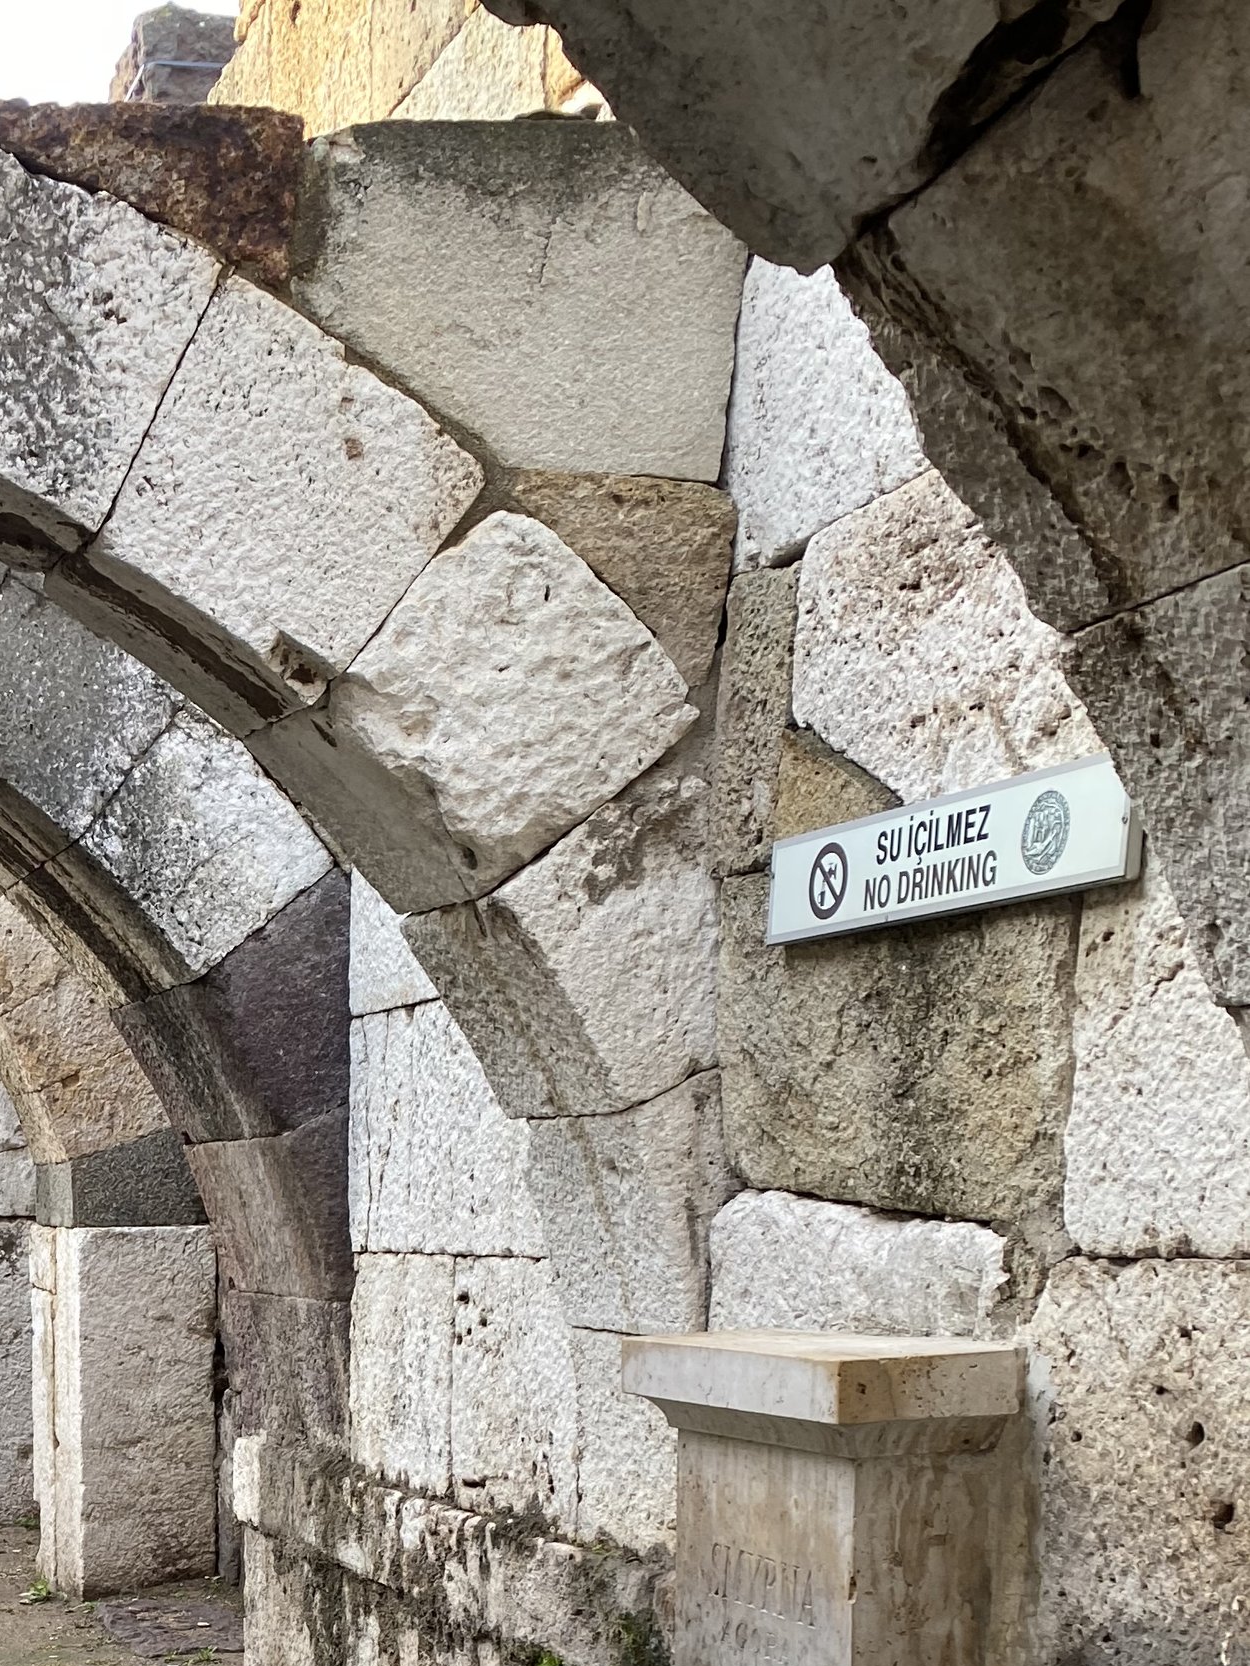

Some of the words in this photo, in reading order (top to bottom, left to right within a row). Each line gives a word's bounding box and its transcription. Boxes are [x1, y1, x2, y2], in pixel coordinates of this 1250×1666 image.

[876, 826, 901, 865] SU
[907, 804, 992, 865] İÇİLMEZ
[863, 874, 890, 912] NO
[897, 850, 998, 905] DRINKING
